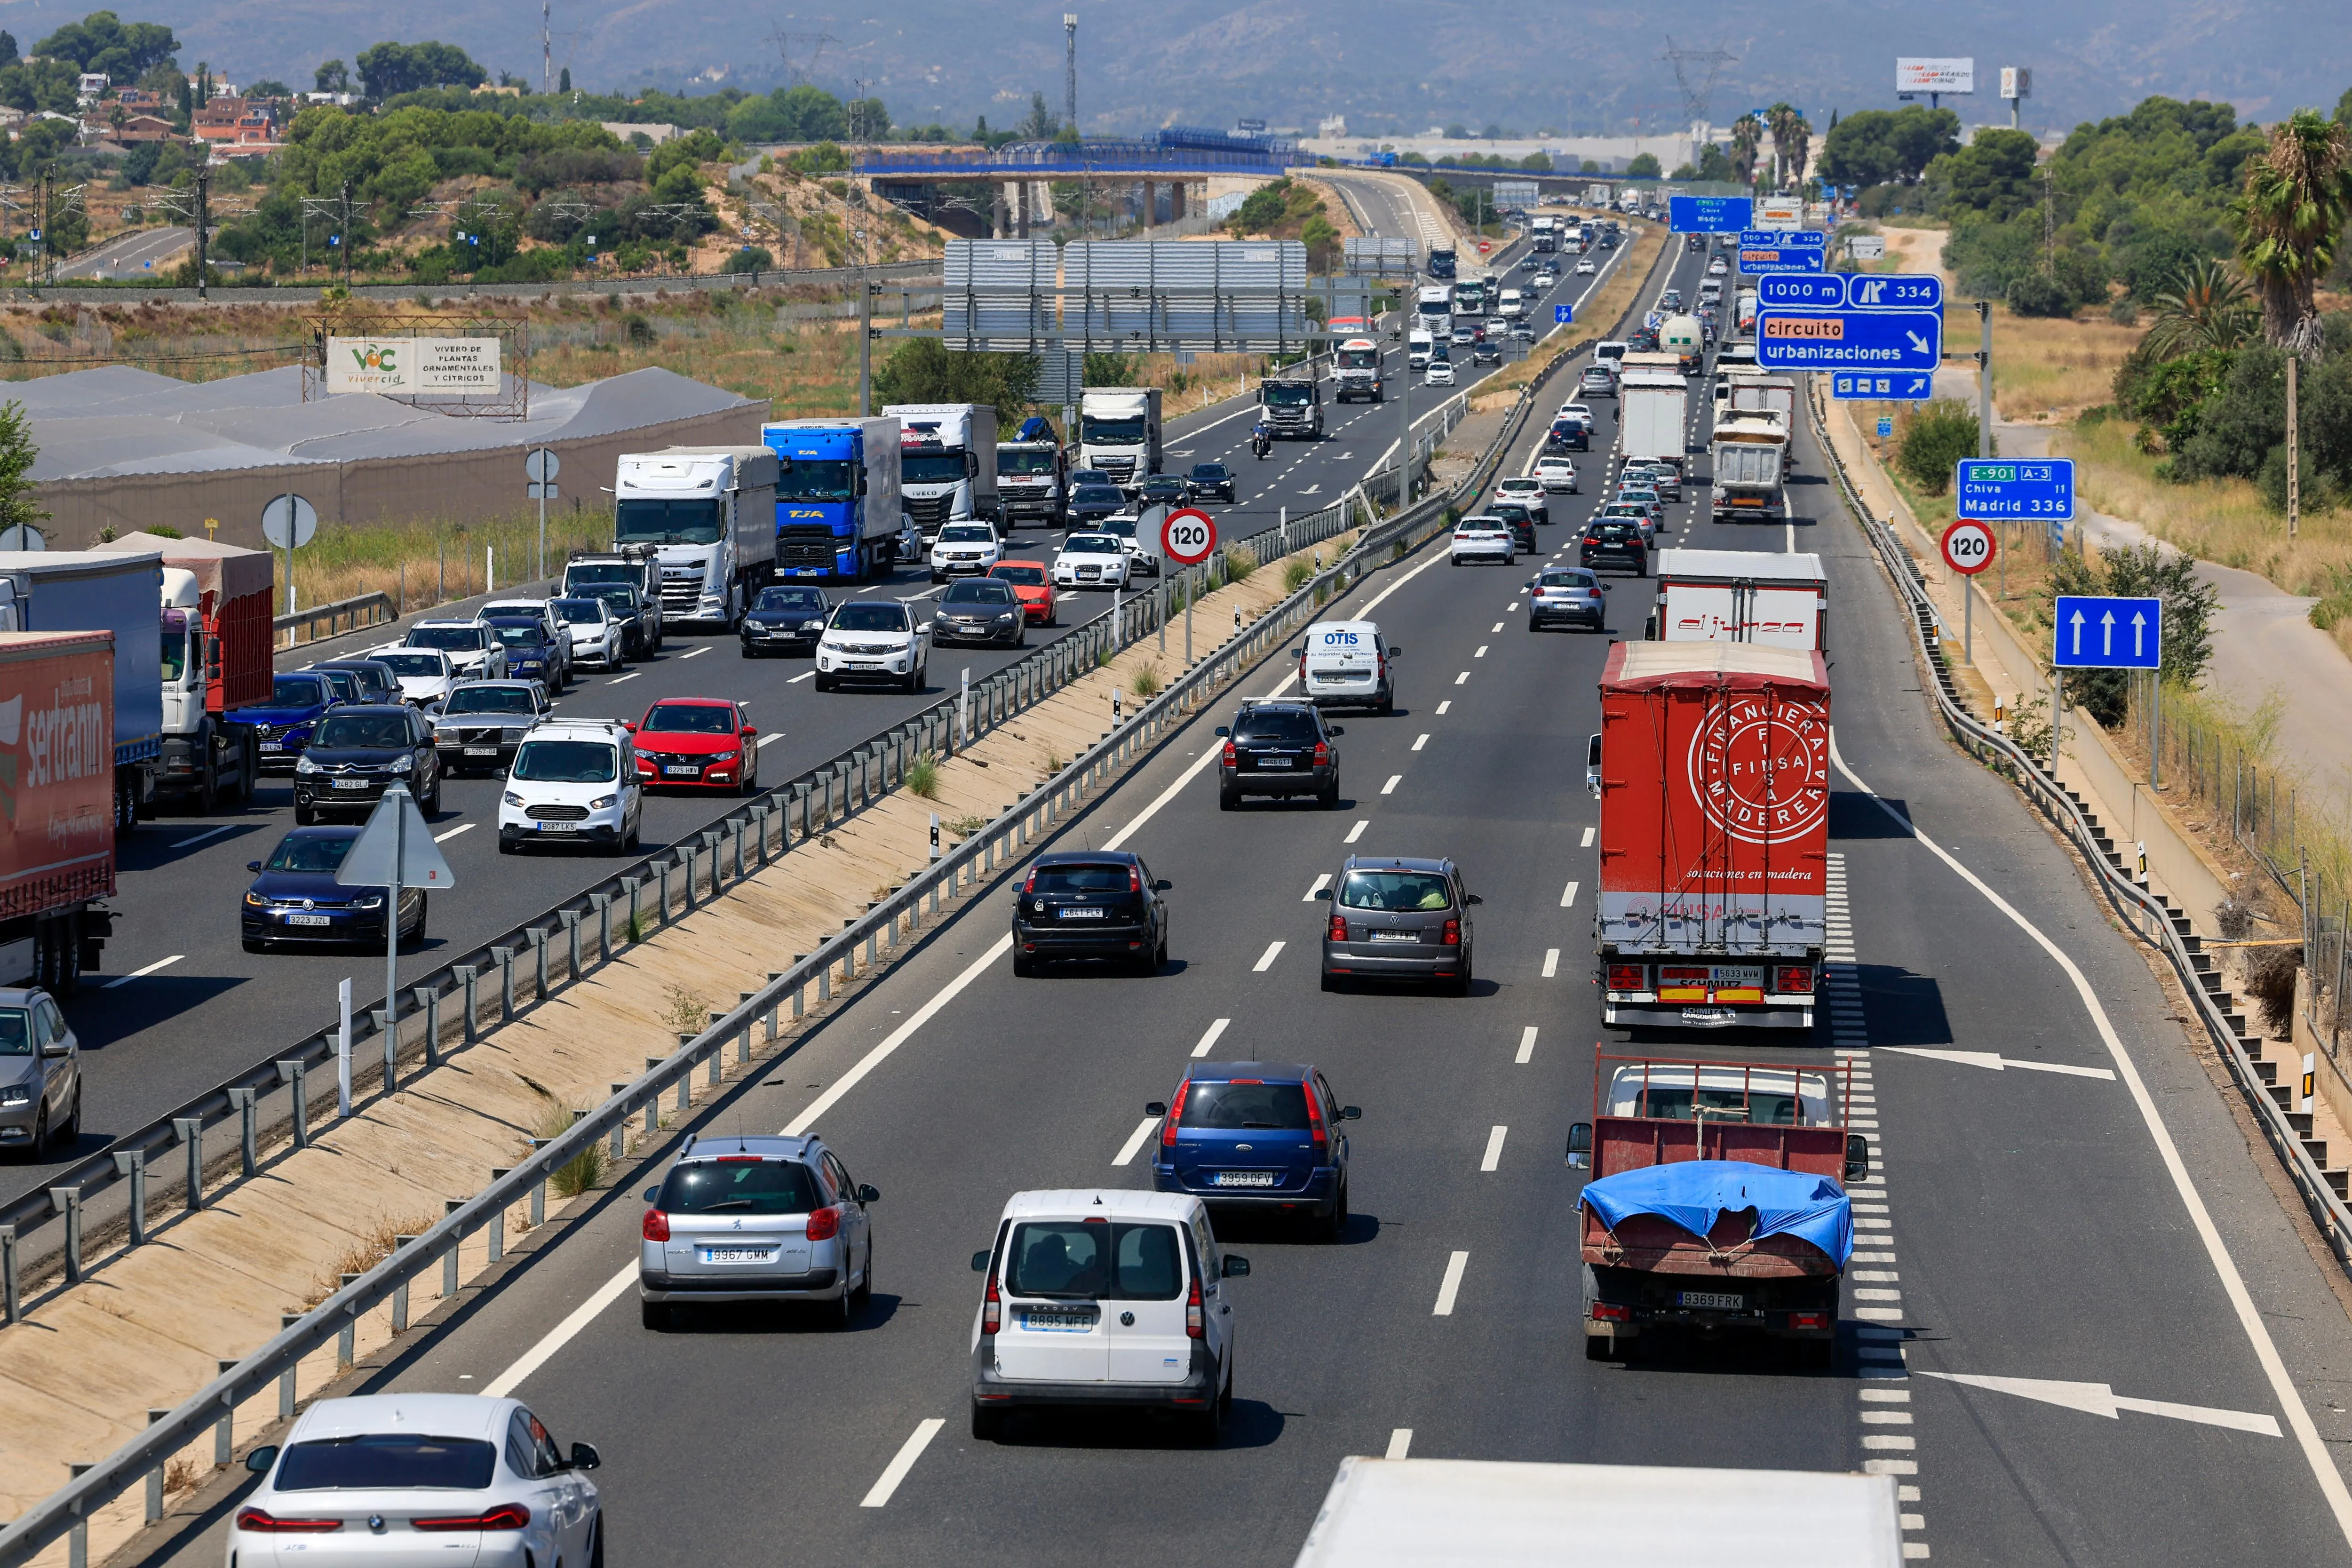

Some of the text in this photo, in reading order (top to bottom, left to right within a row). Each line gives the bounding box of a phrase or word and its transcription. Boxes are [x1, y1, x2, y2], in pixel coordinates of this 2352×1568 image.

[1769, 284, 1836, 297] 1000 m
[1896, 286, 1931, 299] 334
[1767, 320, 1841, 336] circuito
[1767, 345, 1901, 360] urbanizaciones
[1971, 469, 2049, 479] E-901 A-3
[1965, 484, 2065, 493] Chiva 11
[1965, 499, 2066, 512] Madrid 336
[1173, 527, 1205, 544] 120
[1952, 538, 1985, 556] 120
[1325, 633, 1359, 645] OTIS
[1707, 705, 1824, 763] FINANCIERA
[1732, 756, 1804, 775] FINSA
[1758, 728, 1778, 802] FINSA
[1686, 867, 1812, 880] soluciones en madera
[1661, 903, 1723, 921] FINSA
[1378, 931, 1414, 940] 7346 FWP
[1743, 970, 1758, 978] MVM
[1221, 1173, 1271, 1184] 3959 DFV
[714, 1249, 743, 1260] 9967
[1685, 1294, 1740, 1307] 9369 FRK
[1030, 1315, 1089, 1328] 8895 MFF
